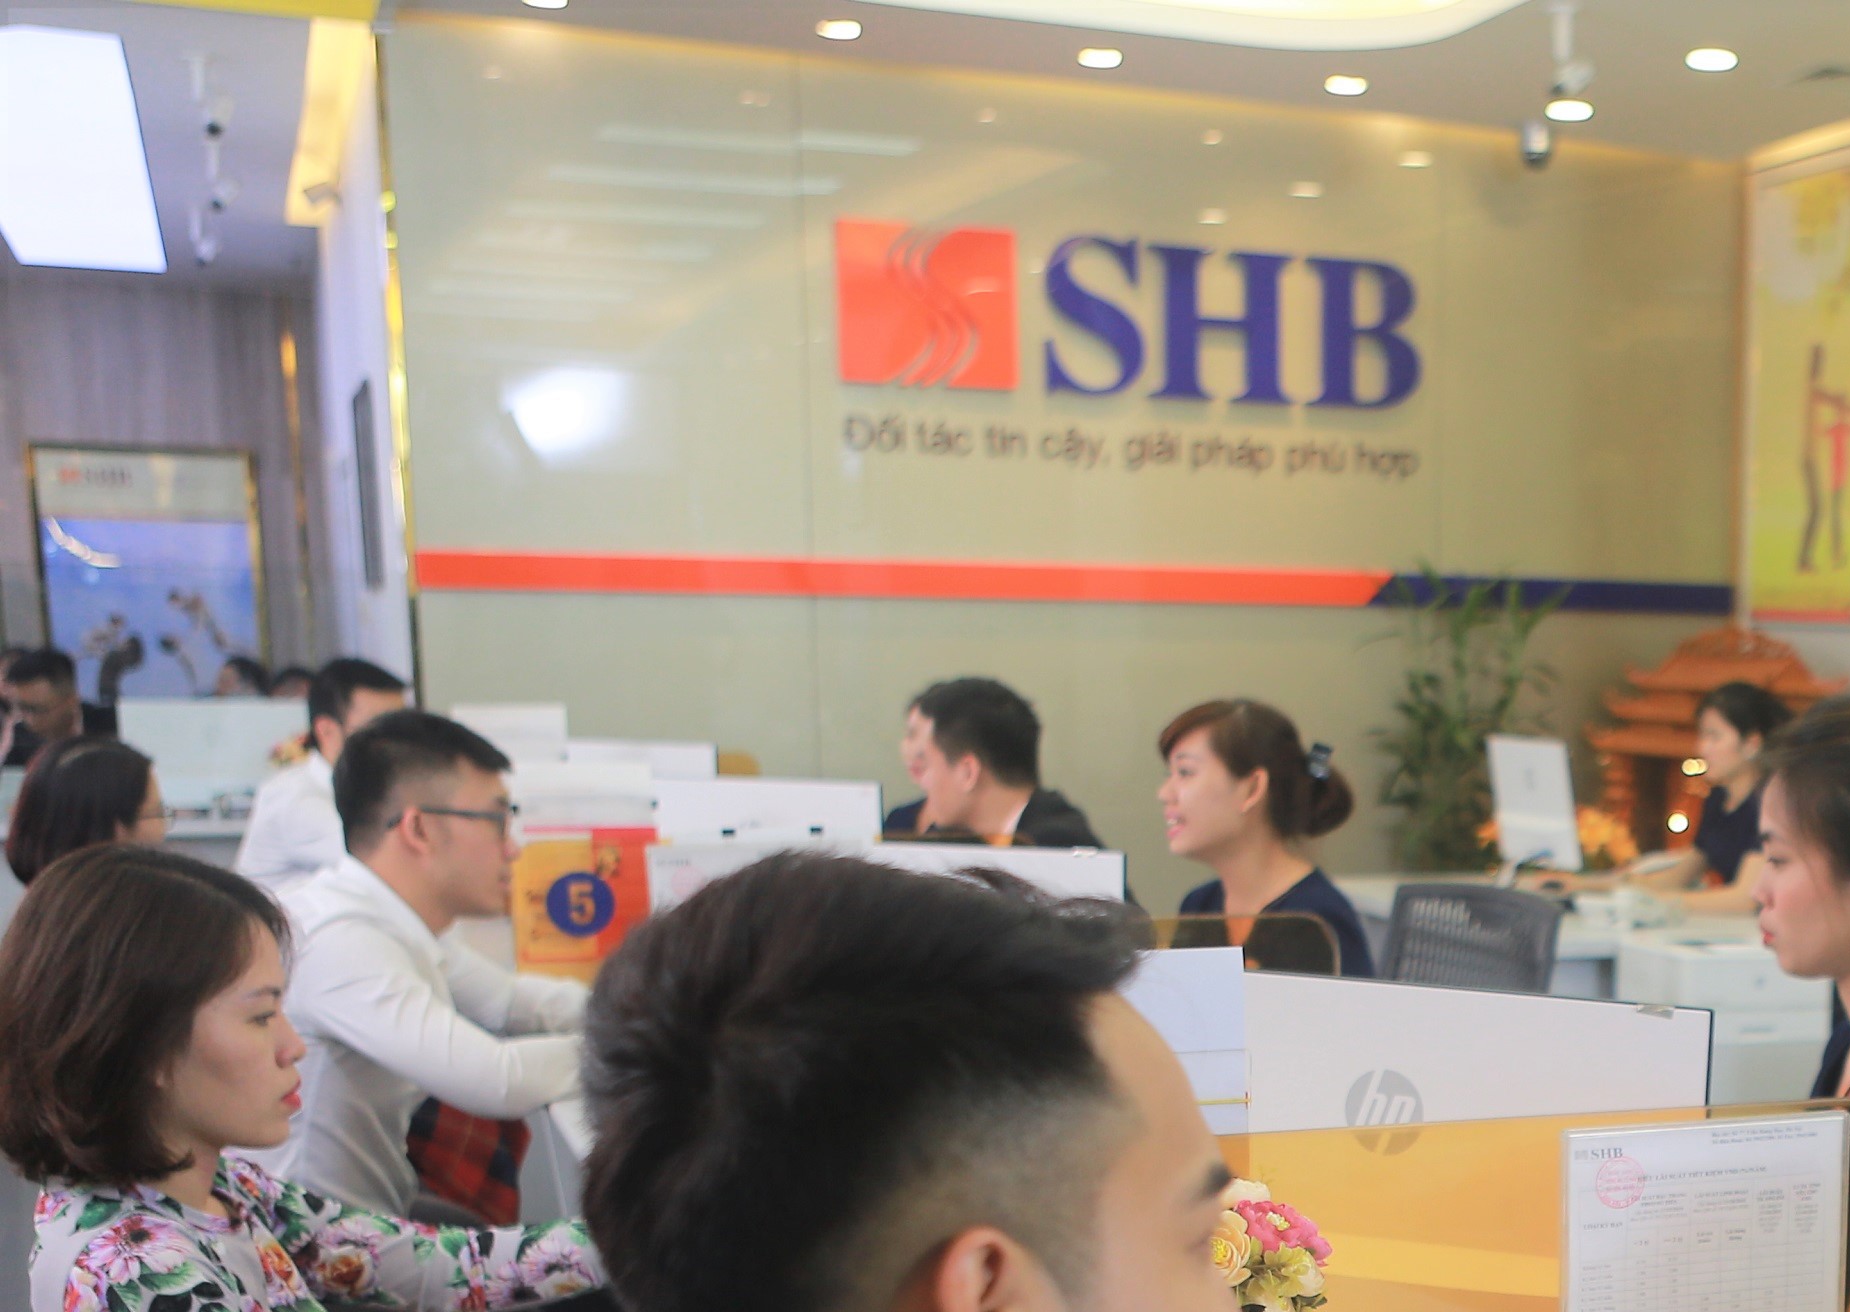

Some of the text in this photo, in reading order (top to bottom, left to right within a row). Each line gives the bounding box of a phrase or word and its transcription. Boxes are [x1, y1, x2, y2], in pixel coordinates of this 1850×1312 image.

[1044, 235, 1422, 412] SHB
[843, 414, 904, 452] Đối
[913, 421, 972, 457] tác
[985, 423, 1028, 459] tin
[1191, 434, 1273, 474] pháp
[567, 881, 597, 927] 5
[1347, 1069, 1421, 1157] hp
[1590, 1147, 1623, 1160] SHB
